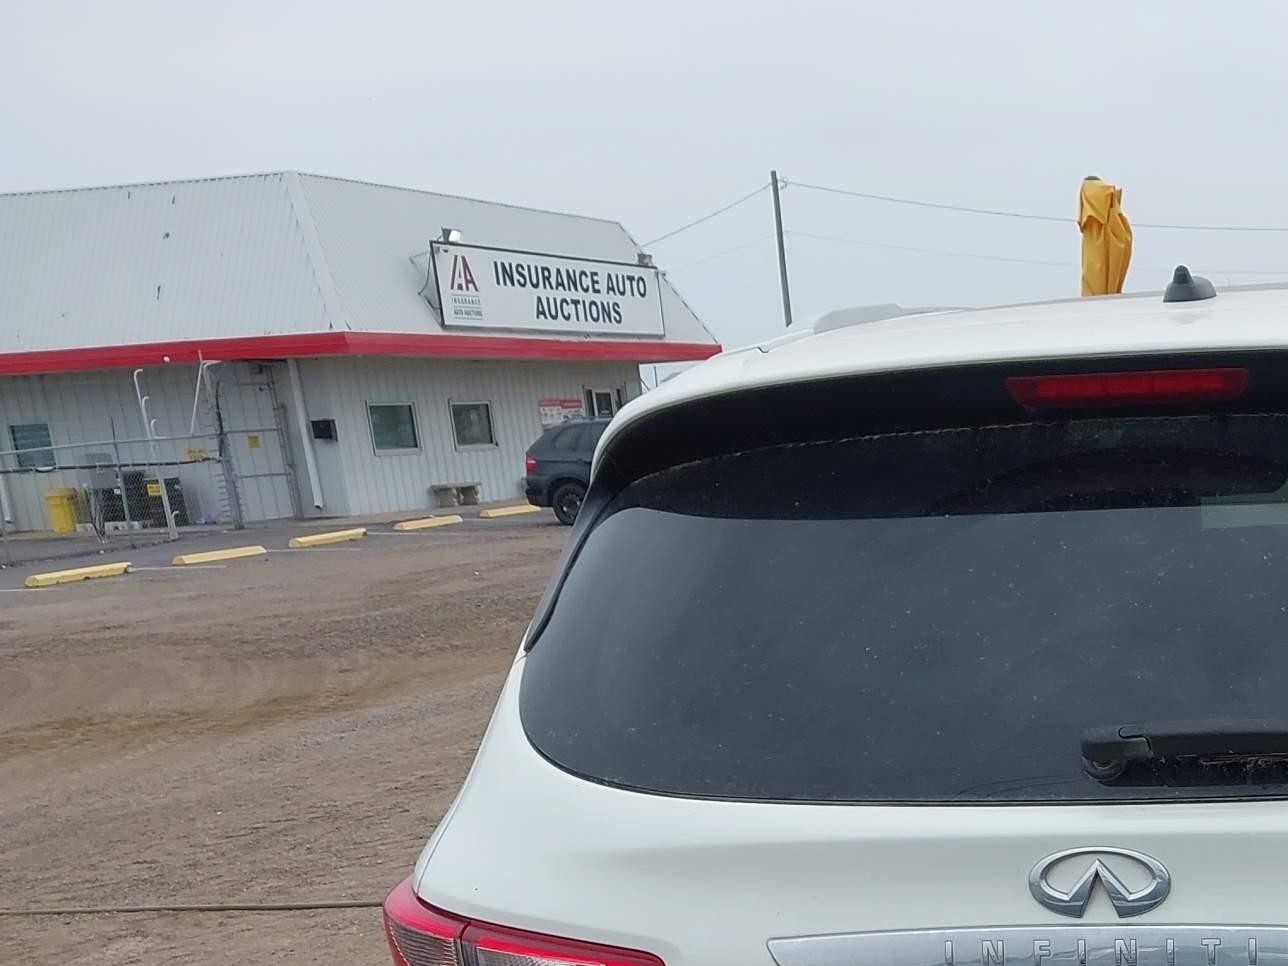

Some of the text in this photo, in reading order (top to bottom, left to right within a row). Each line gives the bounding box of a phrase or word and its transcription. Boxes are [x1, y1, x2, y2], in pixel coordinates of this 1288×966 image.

[493, 260, 647, 298] INSURANCE AUTO
[535, 295, 623, 325] AUCTIONS
